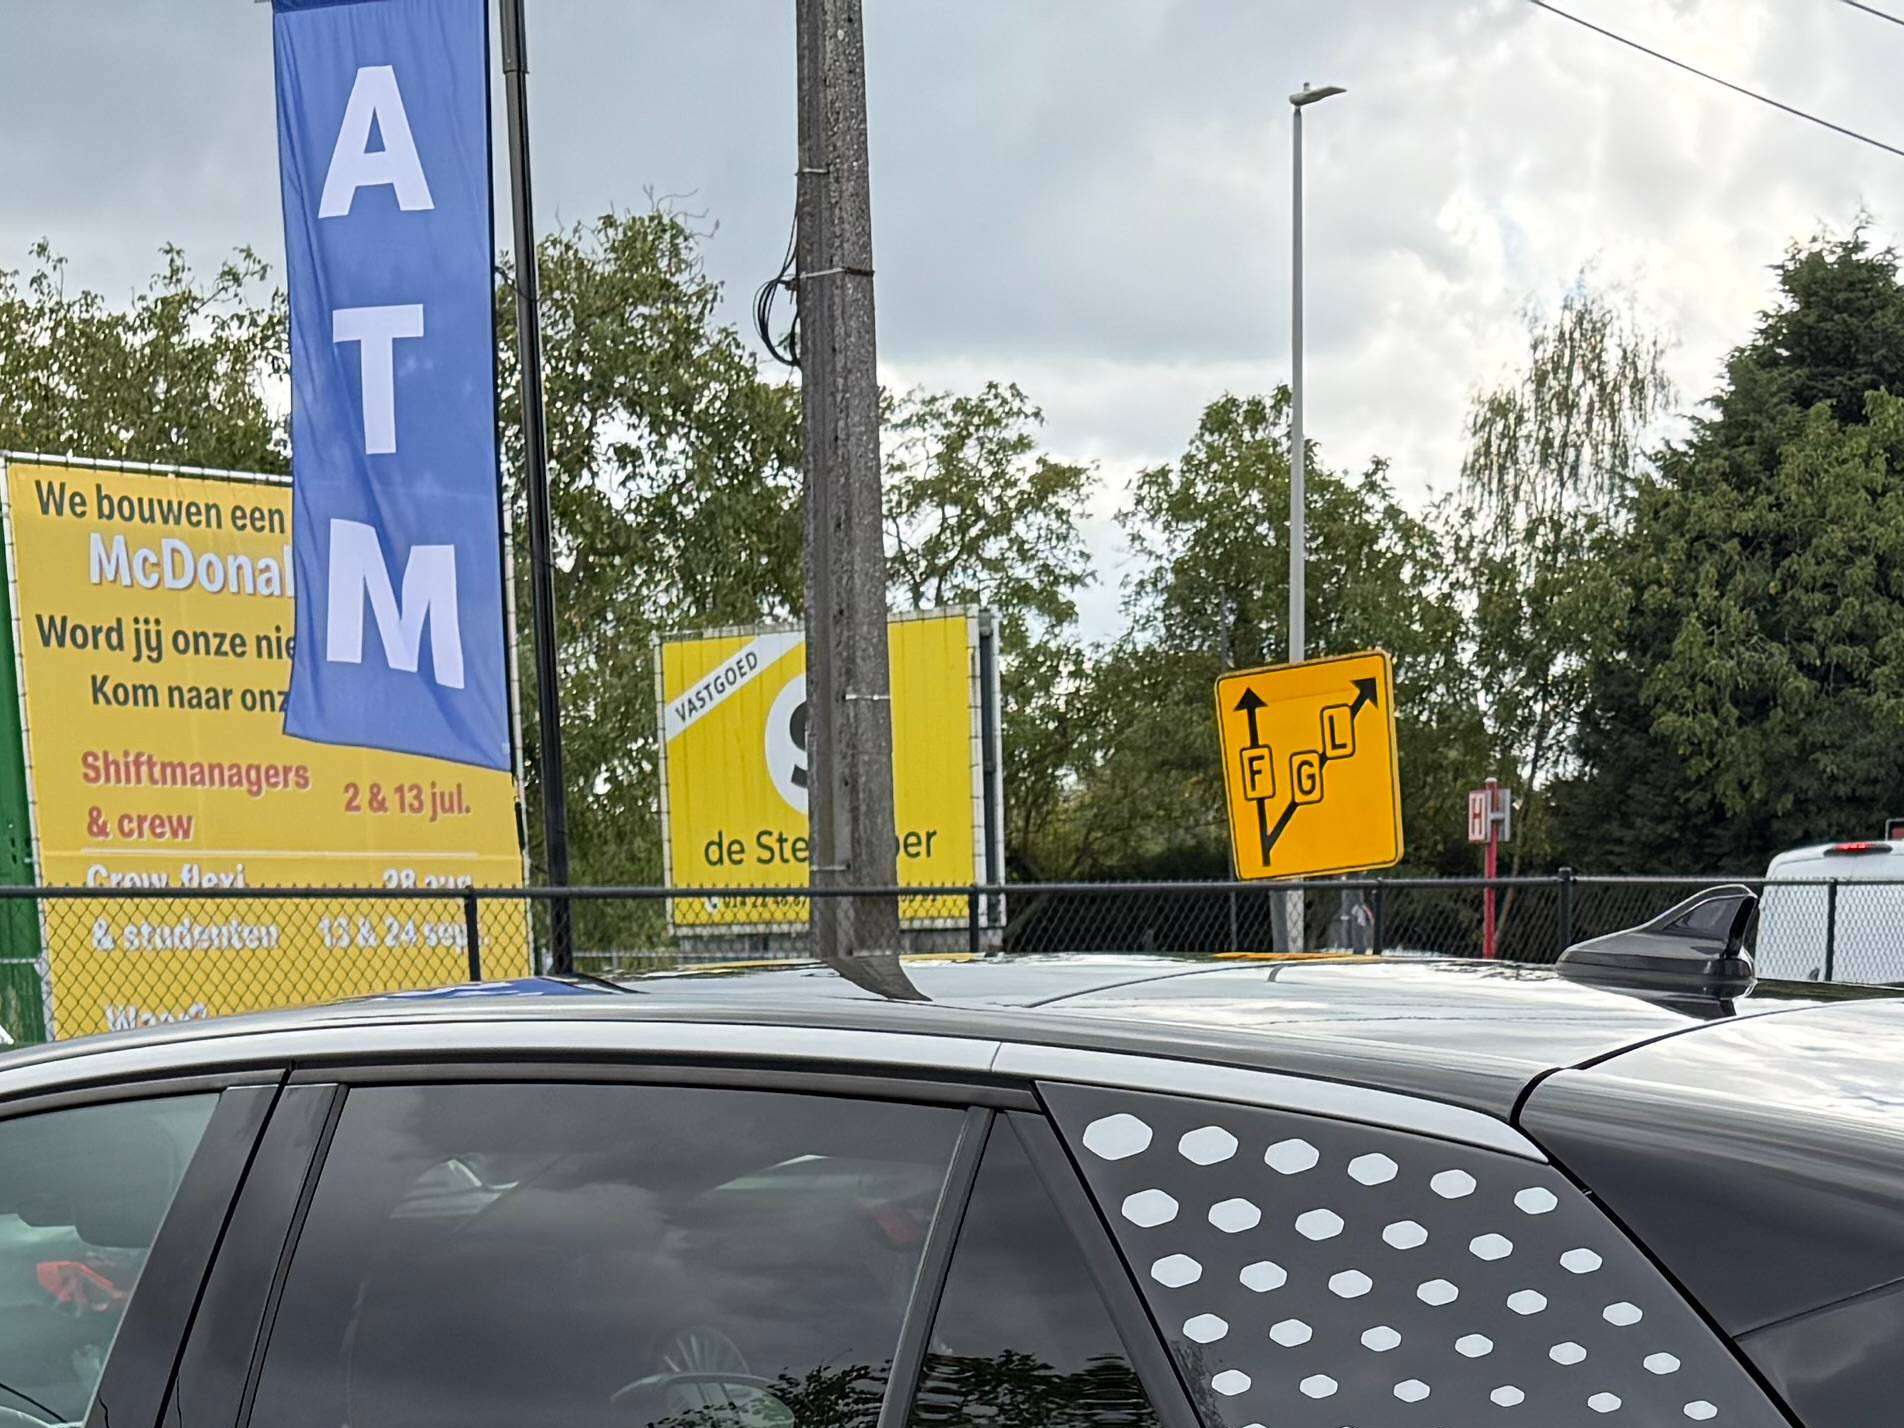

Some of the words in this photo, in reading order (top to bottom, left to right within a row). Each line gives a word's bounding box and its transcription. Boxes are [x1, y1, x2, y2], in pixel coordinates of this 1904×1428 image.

[35, 480, 87, 519] We
[96, 483, 223, 529] bouwen
[231, 504, 286, 534] een
[35, 614, 125, 651] Word
[172, 628, 247, 658] onze
[91, 674, 159, 708] Kom
[168, 683, 233, 711] naar
[675, 651, 759, 723] VASTGOED
[1328, 715, 1347, 751] L
[81, 750, 311, 798] Shiftmanagers
[1248, 755, 1265, 792] F
[1297, 760, 1316, 796] G
[344, 782, 362, 813] 2
[368, 783, 389, 813] &
[394, 783, 424, 814] 13
[429, 781, 471, 822] jul.
[87, 805, 111, 840] &
[117, 812, 194, 840] crew
[704, 830, 745, 866] de
[123, 914, 280, 950] studenten
[384, 917, 417, 948] 24
